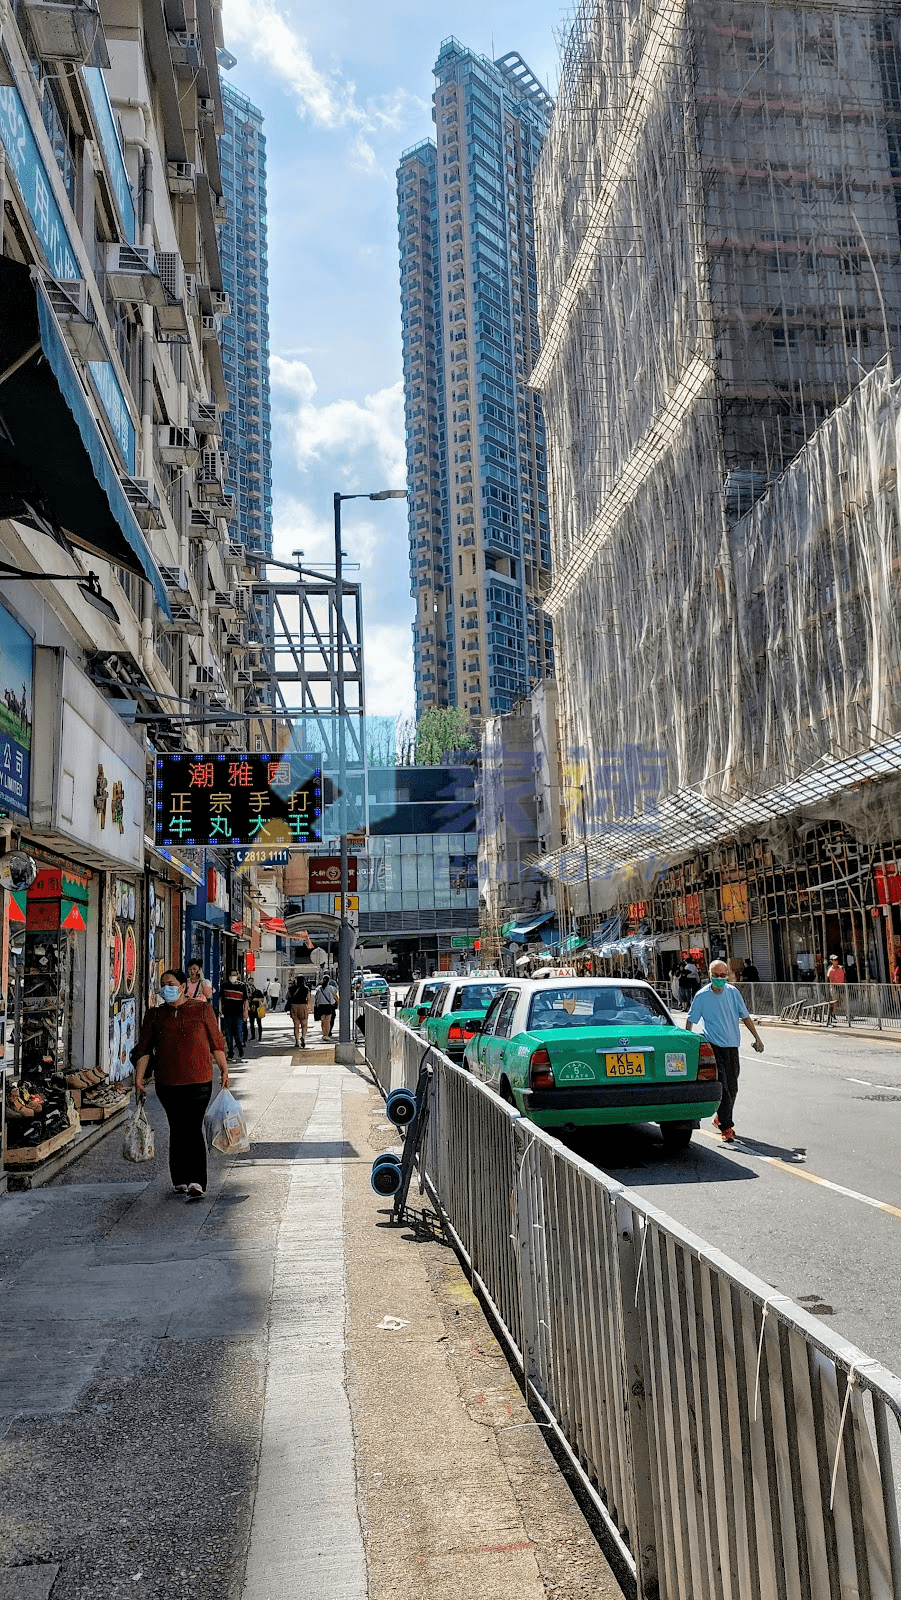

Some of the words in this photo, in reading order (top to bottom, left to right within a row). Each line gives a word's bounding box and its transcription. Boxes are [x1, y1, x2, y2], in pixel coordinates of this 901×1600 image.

[4, 742, 23, 778] 公司
[4, 773, 23, 797] LIMITED
[188, 761, 291, 788] 潮雅園
[169, 791, 310, 814] 正宗手打
[168, 814, 310, 838] 牛丸大王
[244, 851, 267, 863] 2813
[269, 850, 288, 862] 1111
[609, 1064, 643, 1075] 4054
[616, 1054, 634, 1064] KL
[574, 1067, 580, 1075] 5
